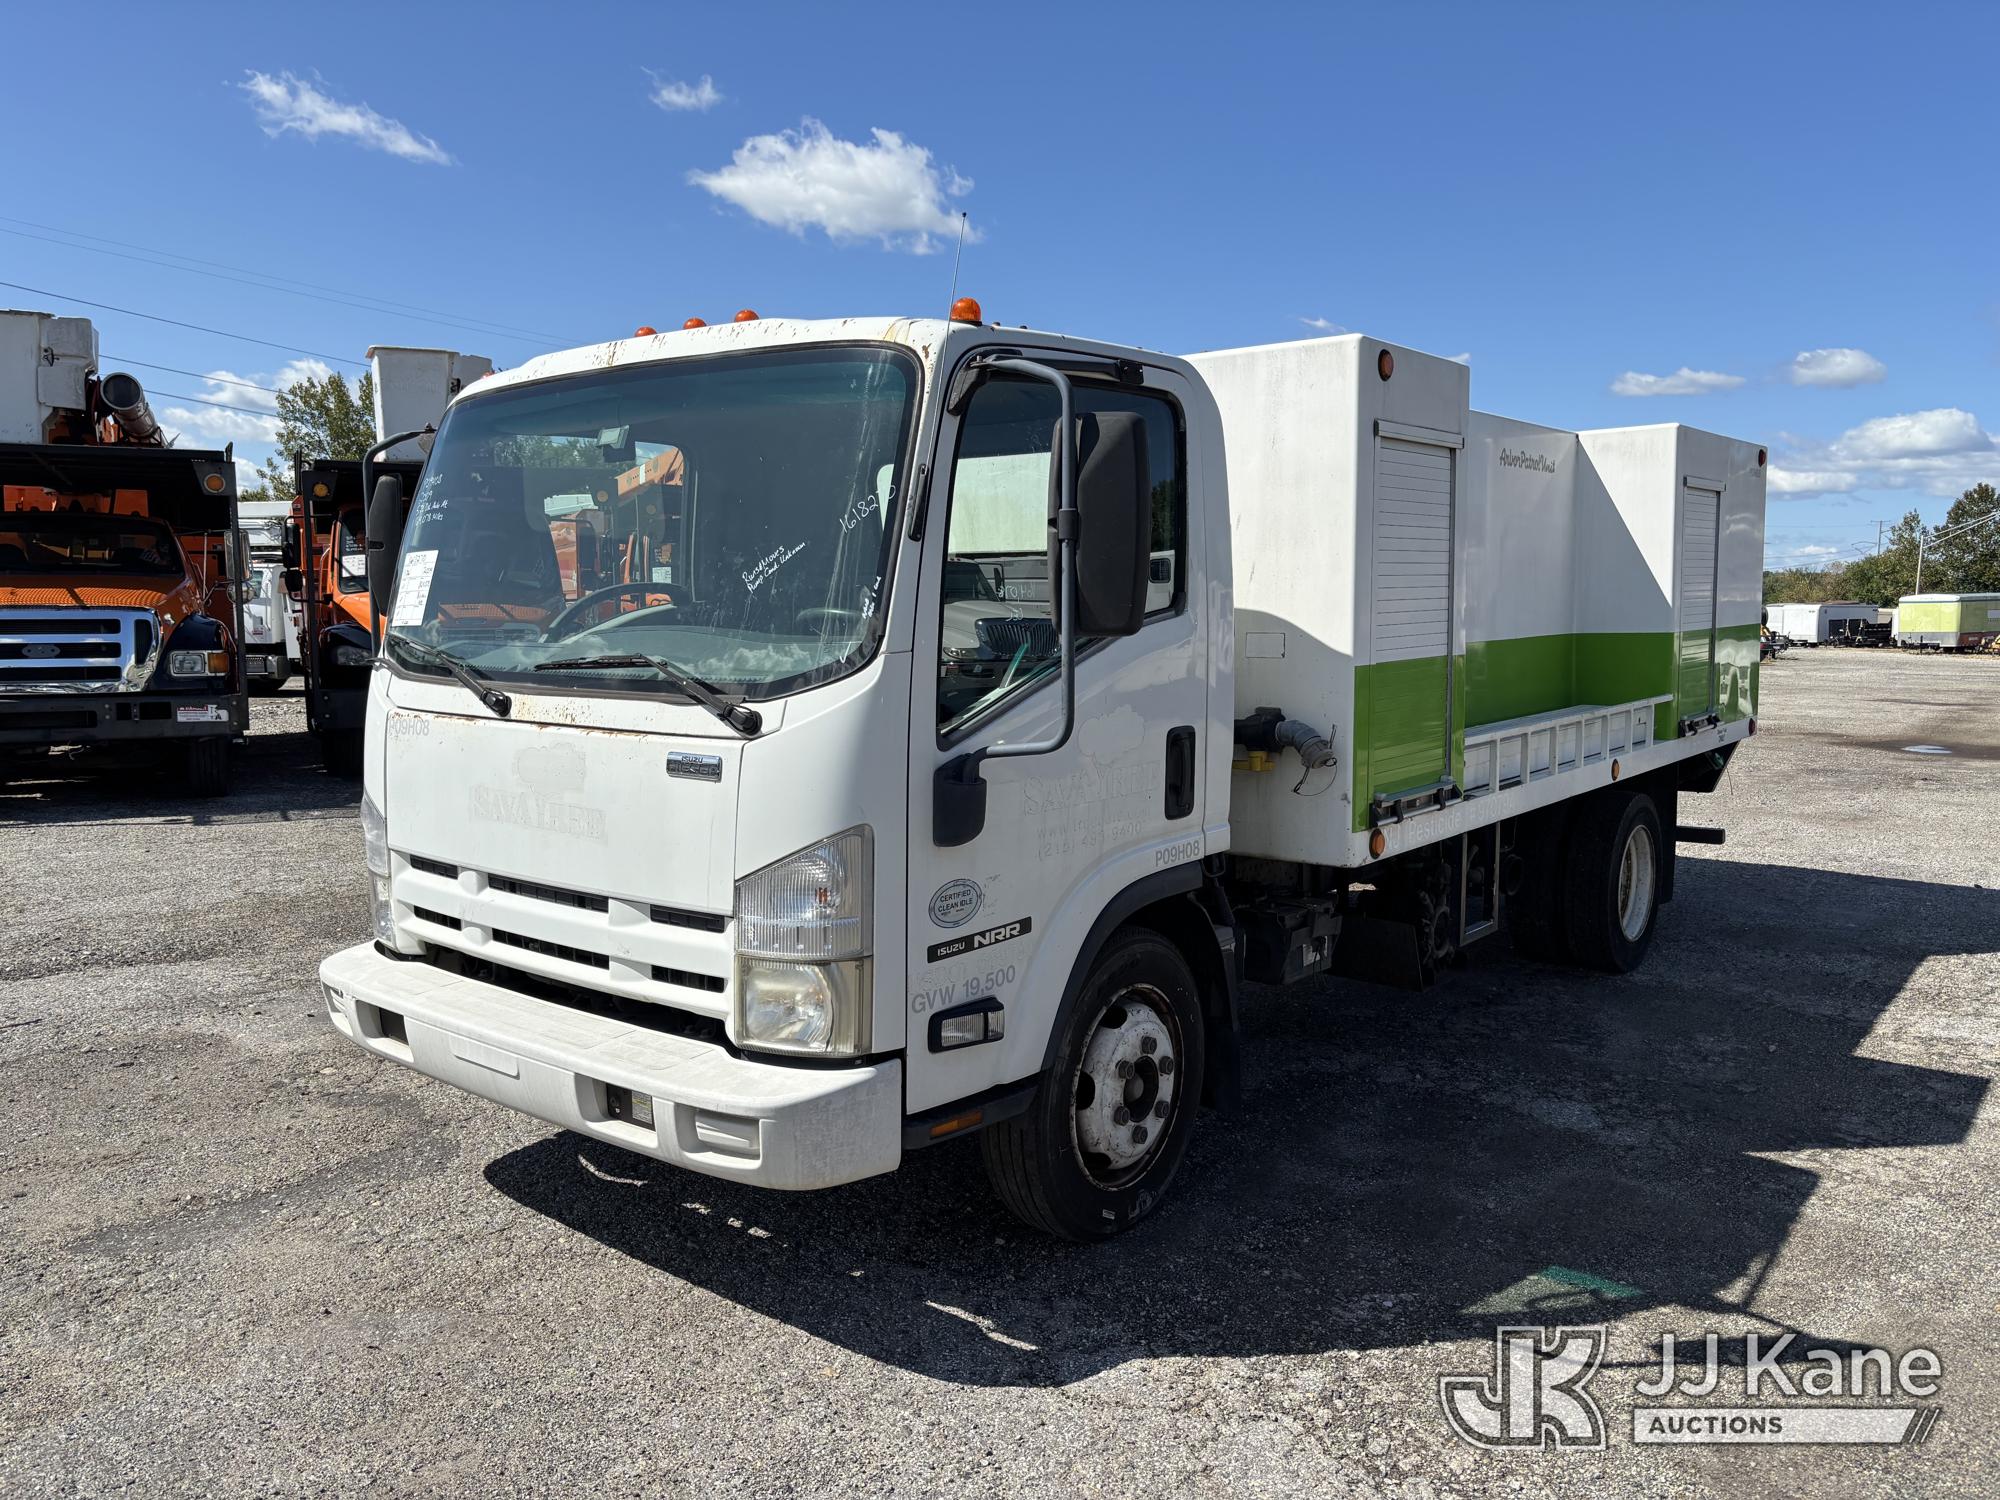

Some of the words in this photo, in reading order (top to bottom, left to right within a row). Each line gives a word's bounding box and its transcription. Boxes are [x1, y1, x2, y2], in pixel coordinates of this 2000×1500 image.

[1155, 839, 1201, 867] P09H08
[938, 902, 959, 913] CLEAN
[959, 897, 973, 909] IDLE
[940, 889, 971, 903] CERTIFIED
[937, 941, 965, 957] ISUZU
[973, 922, 1021, 949] NRR
[911, 983, 956, 1014] GVW
[962, 964, 1016, 998] 19,500
